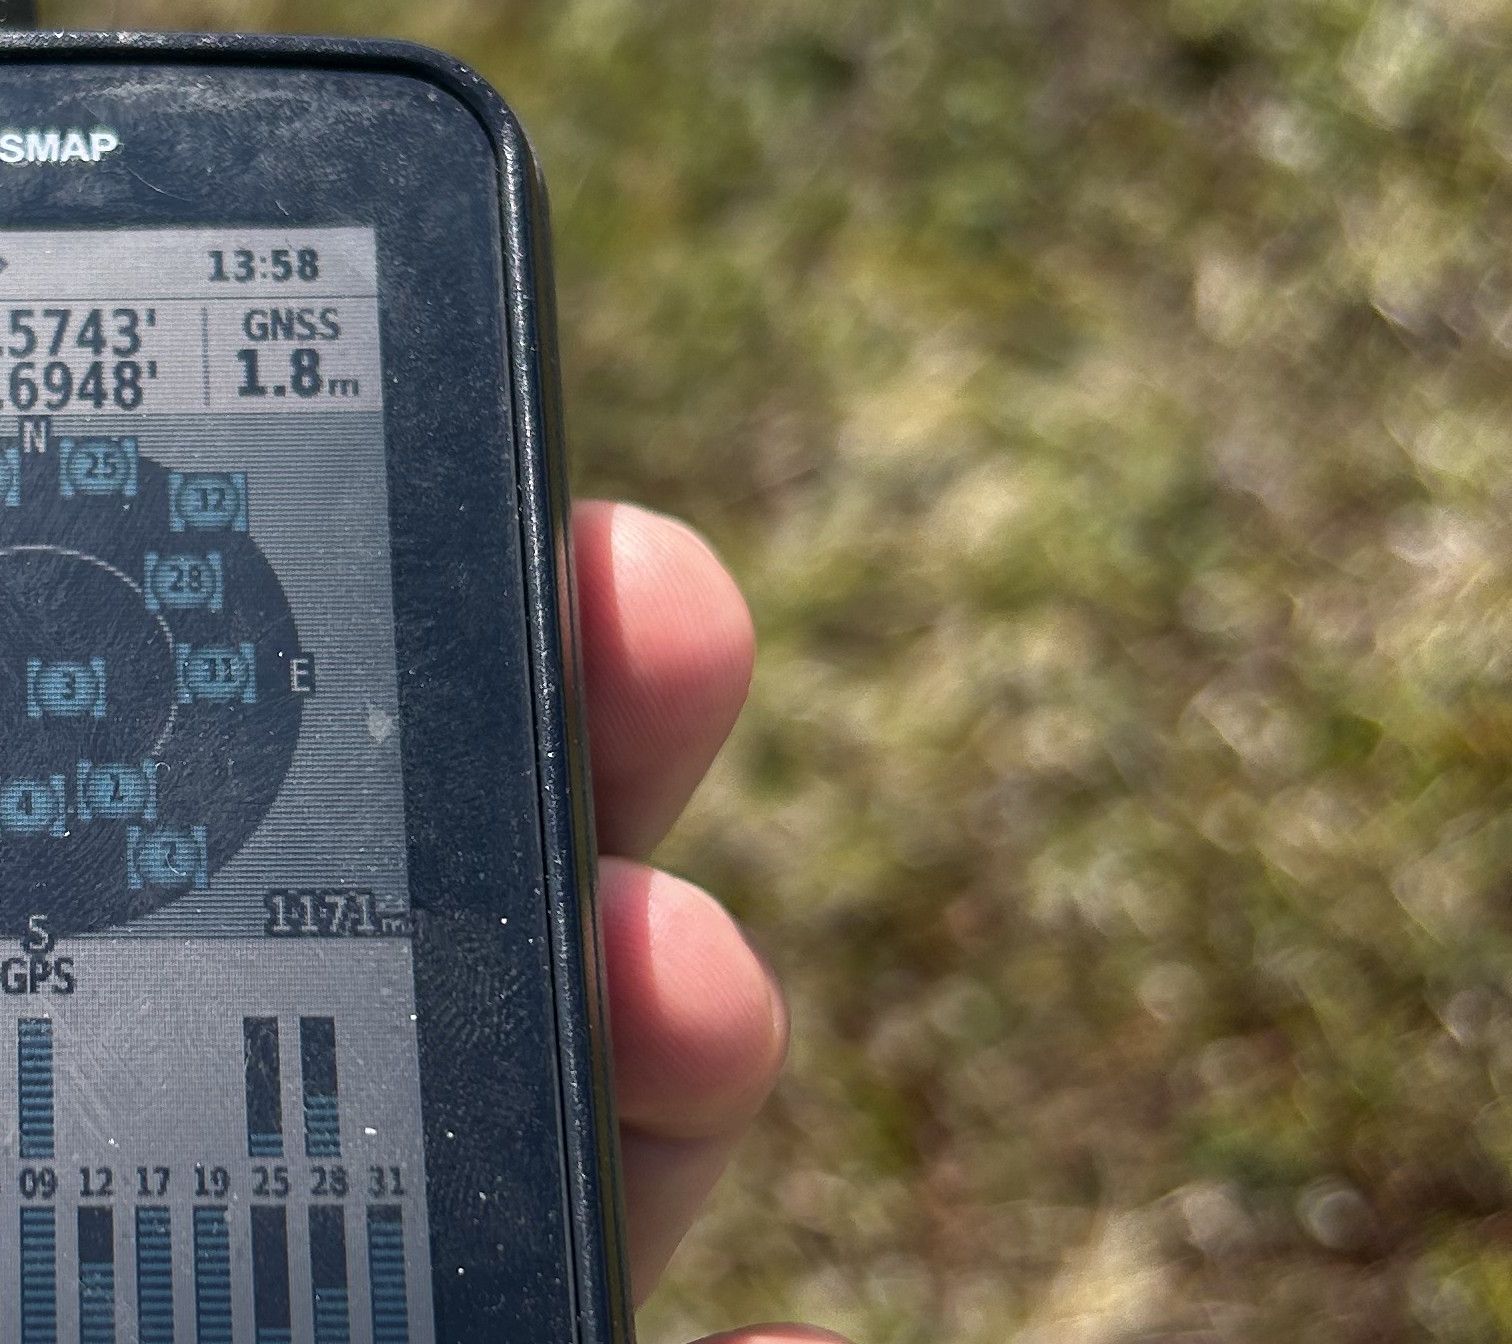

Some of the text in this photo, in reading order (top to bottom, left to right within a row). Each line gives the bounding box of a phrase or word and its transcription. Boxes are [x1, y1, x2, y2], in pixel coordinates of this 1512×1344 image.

[208, 248, 319, 282] 13:58
[242, 307, 342, 341] GNSS
[23, 419, 48, 454] N
[290, 658, 311, 692] E
[28, 913, 50, 950] S
[0, 957, 77, 995] GPS
[19, 1167, 58, 1199] 09
[79, 1166, 114, 1198] 12
[136, 1166, 170, 1198] 17
[194, 1166, 230, 1197] 19
[252, 1166, 290, 1197] 25
[310, 1166, 349, 1197] 28
[368, 1166, 406, 1197] 31
